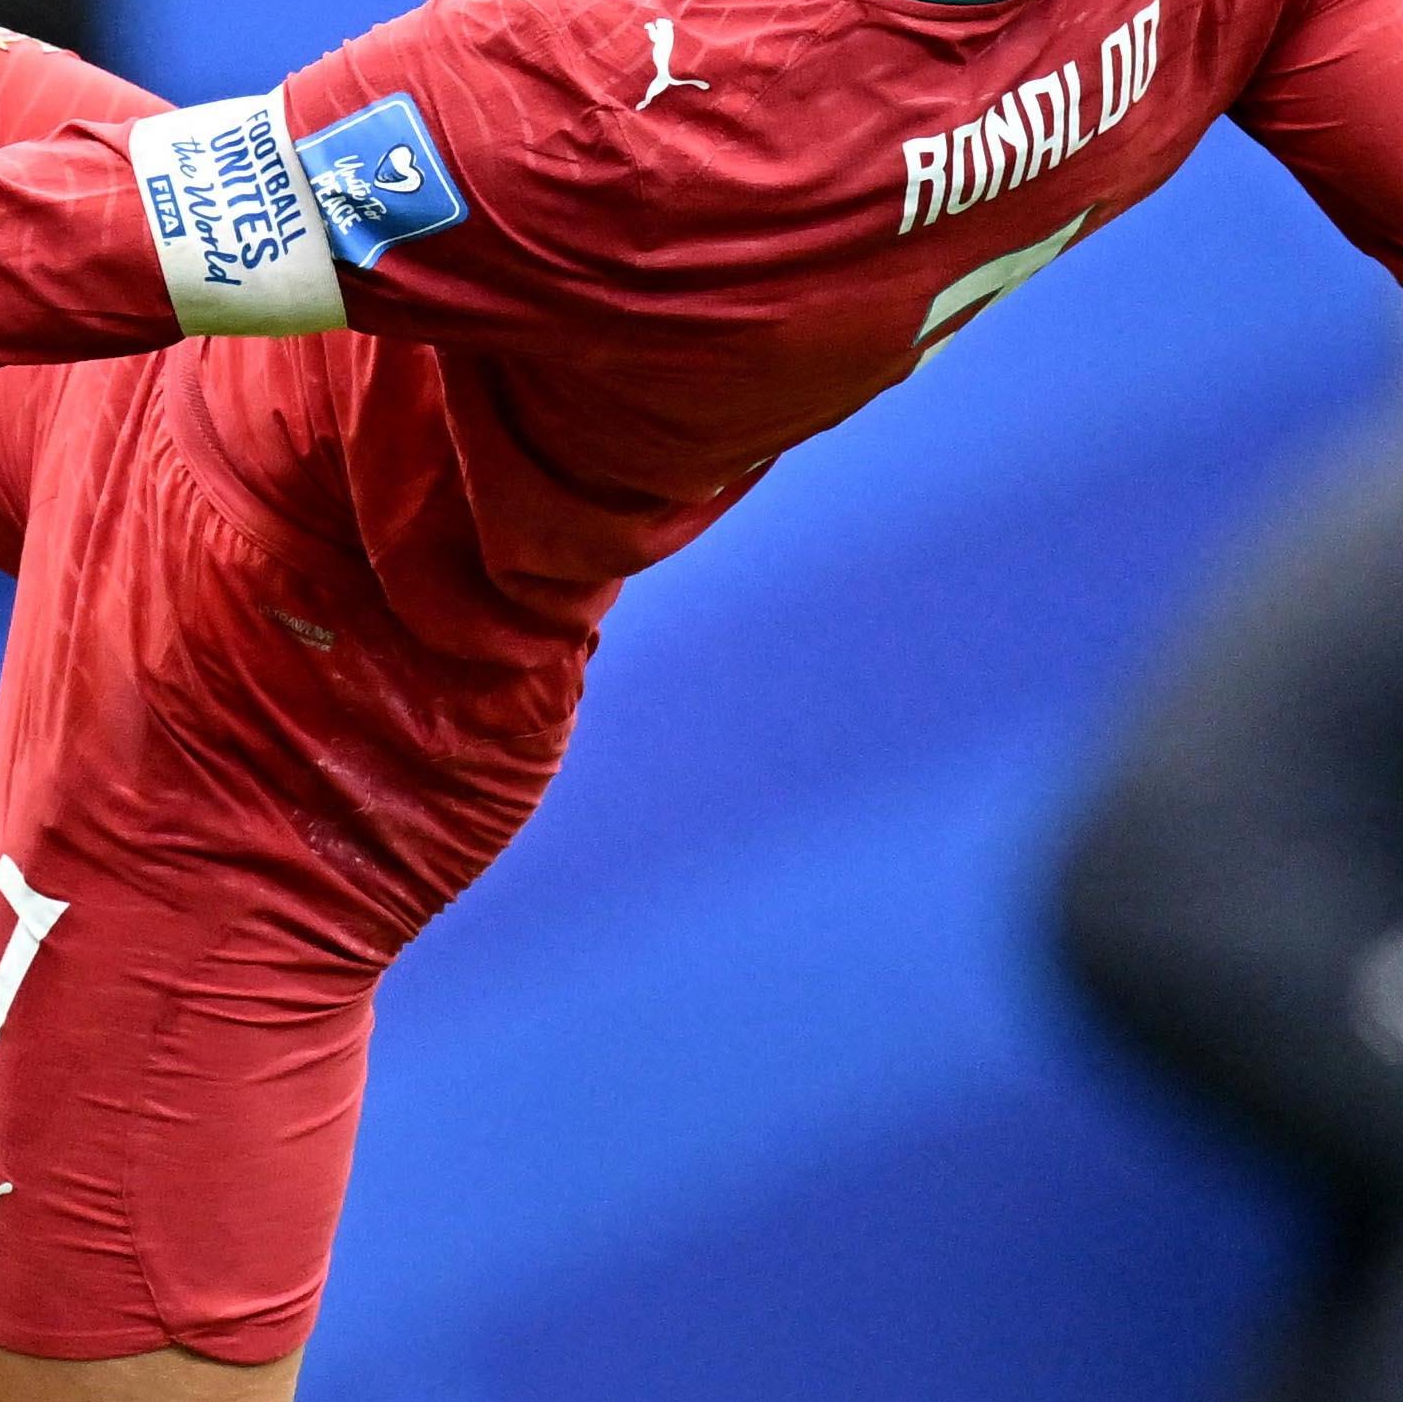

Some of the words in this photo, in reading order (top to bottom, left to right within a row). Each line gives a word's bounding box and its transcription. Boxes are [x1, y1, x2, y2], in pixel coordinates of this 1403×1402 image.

[171, 136, 206, 179] the
[210, 125, 279, 269] UNITES
[246, 109, 306, 255] FOOTBALL
[150, 177, 182, 236] FIFA
[183, 183, 242, 285] World
[310, 170, 362, 235] PEACE
